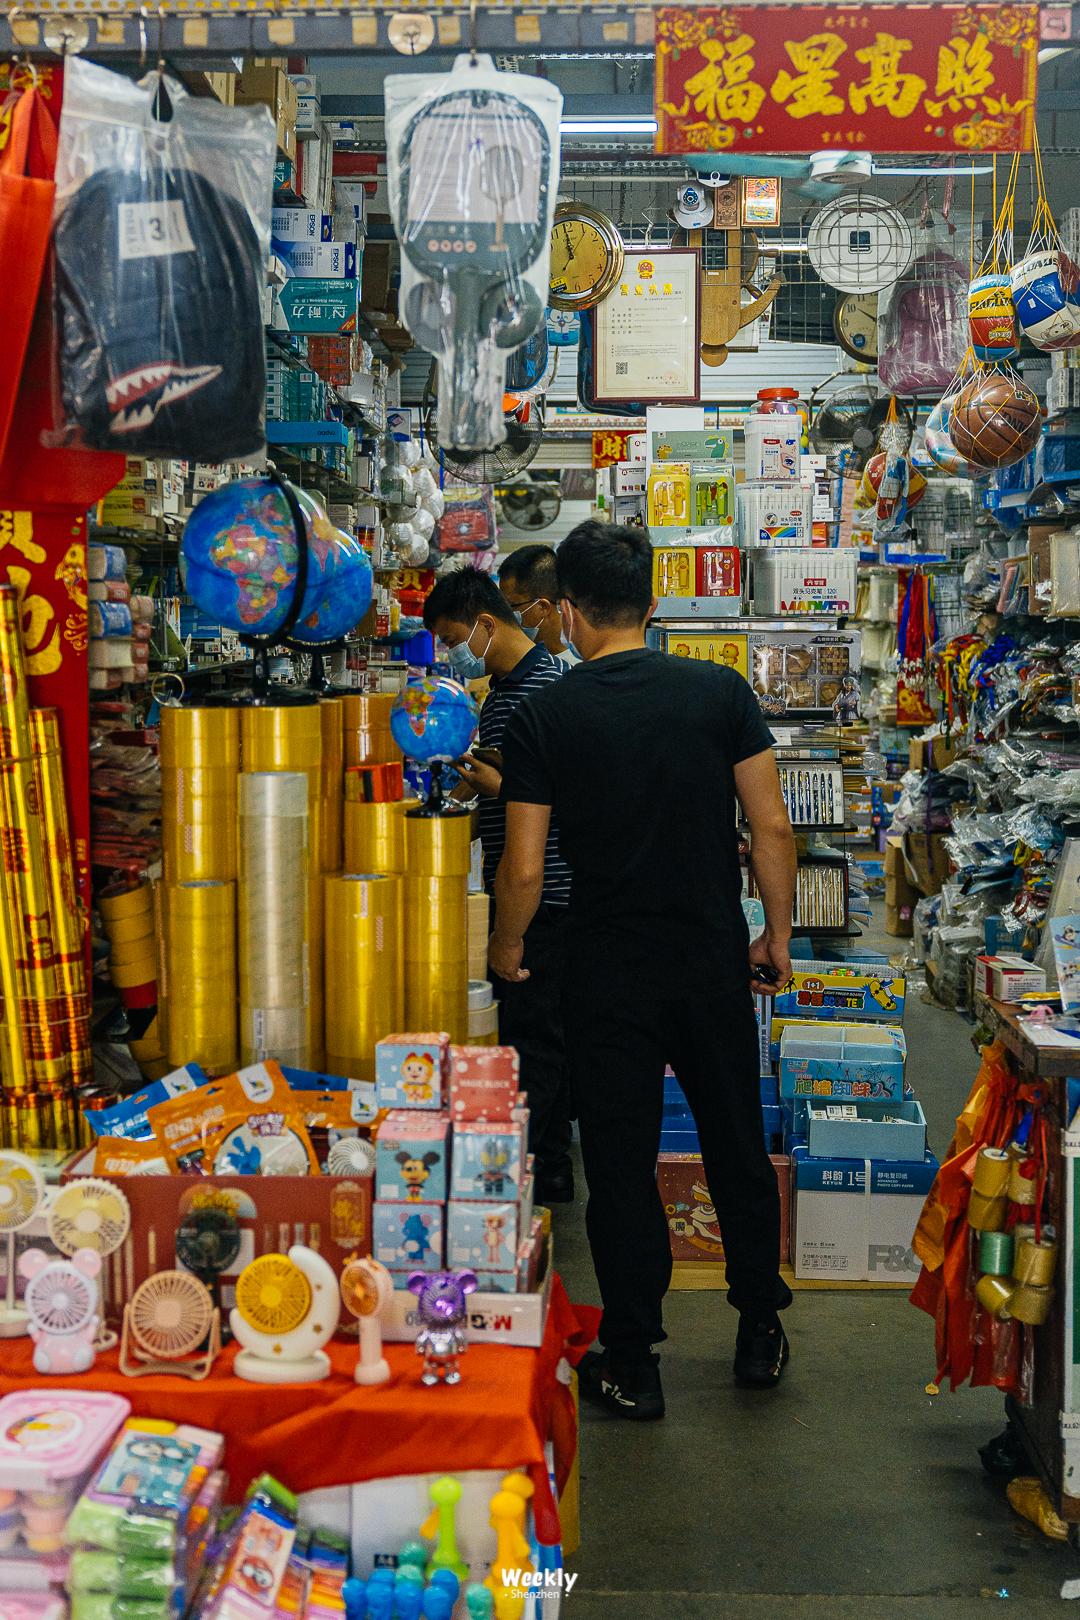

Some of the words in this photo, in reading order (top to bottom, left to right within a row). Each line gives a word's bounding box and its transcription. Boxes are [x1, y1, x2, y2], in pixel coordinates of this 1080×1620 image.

[684, 32, 1006, 121] 福星高照
[781, 600, 850, 610] MARKER
